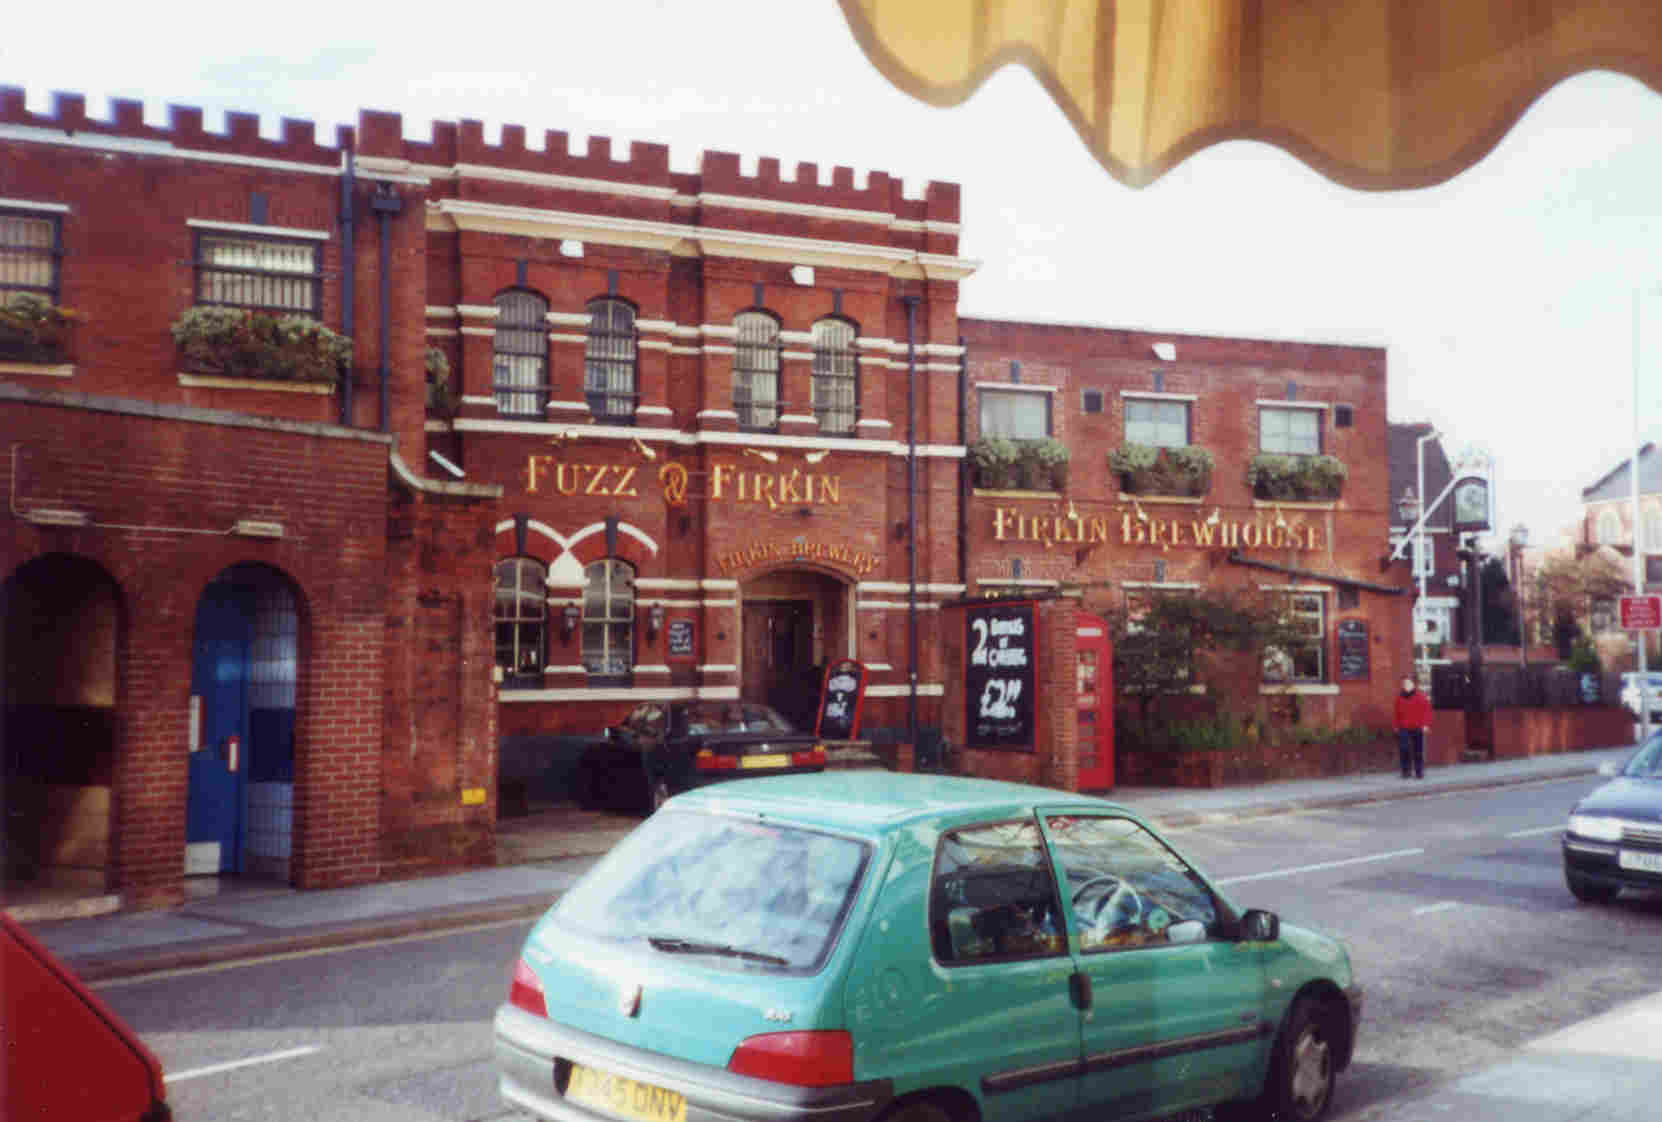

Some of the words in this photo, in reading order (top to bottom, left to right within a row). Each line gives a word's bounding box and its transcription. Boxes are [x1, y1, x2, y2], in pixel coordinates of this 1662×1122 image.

[526, 455, 638, 497] FUZZ
[711, 463, 841, 508] FIRKIN
[993, 505, 1108, 548] FIRKIN
[1120, 511, 1323, 552] BREWHOUSE
